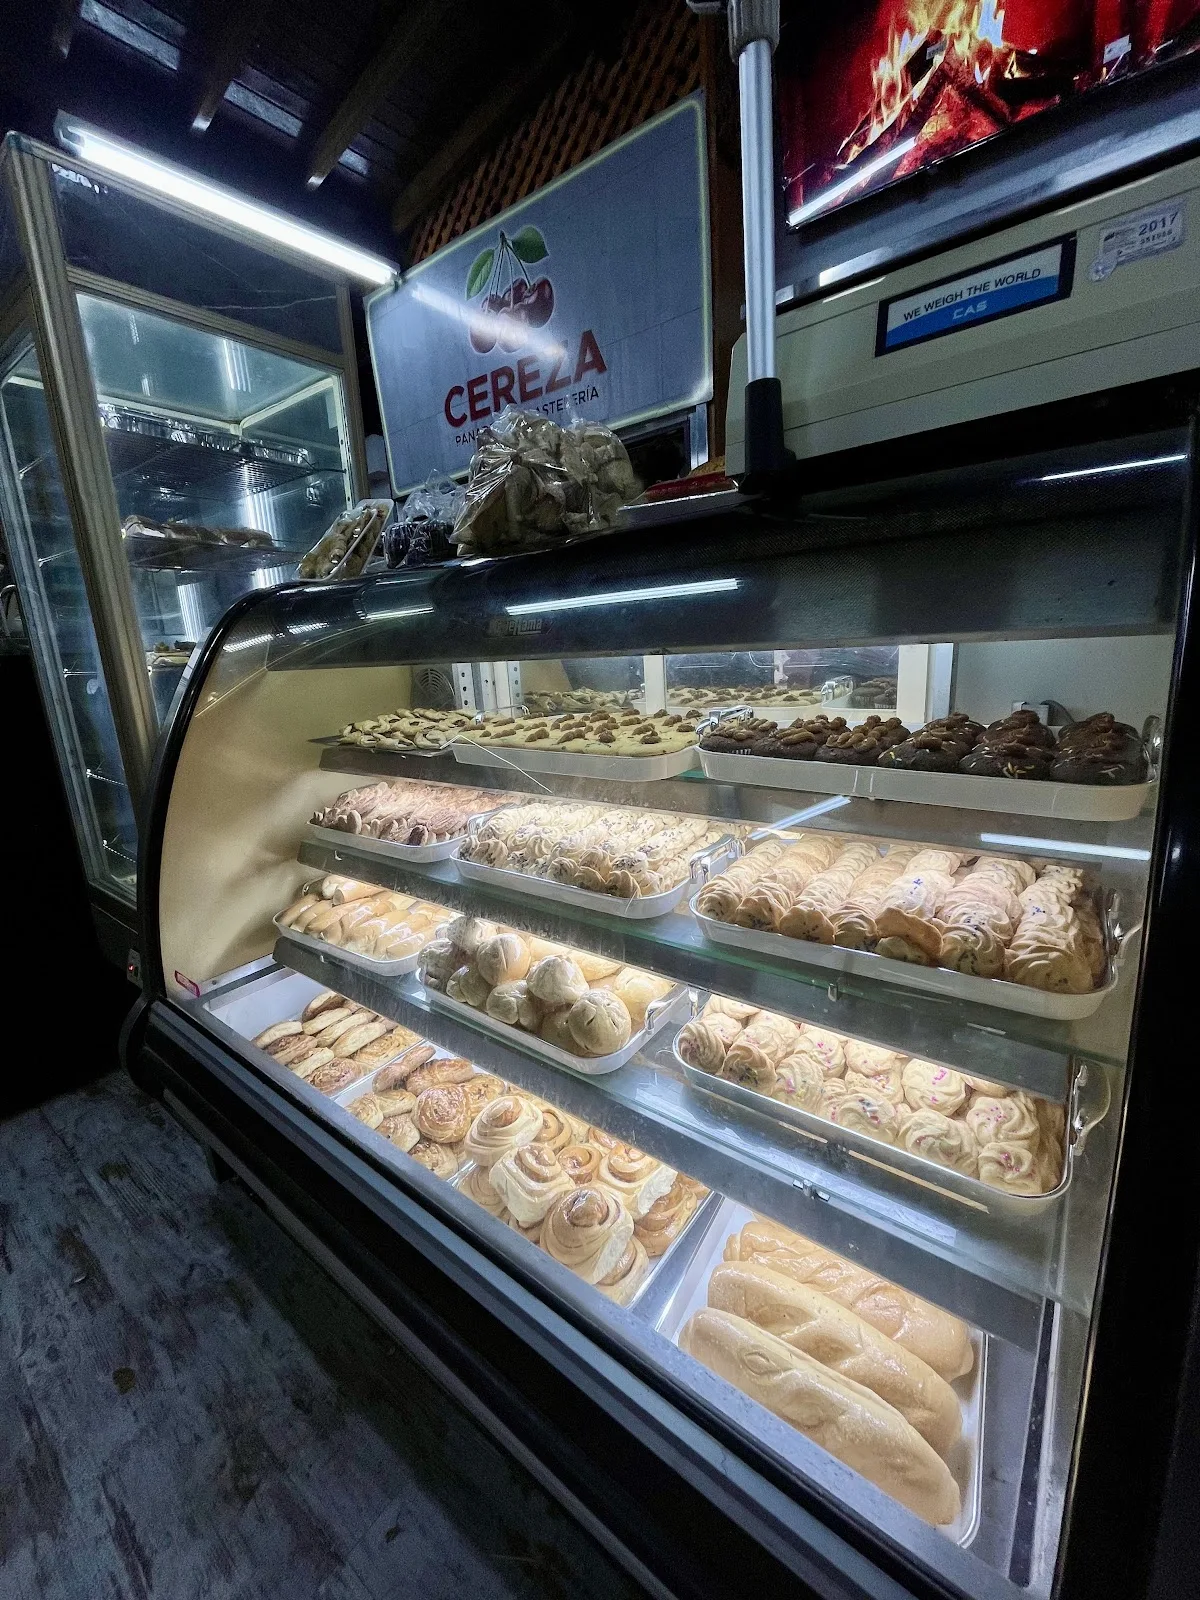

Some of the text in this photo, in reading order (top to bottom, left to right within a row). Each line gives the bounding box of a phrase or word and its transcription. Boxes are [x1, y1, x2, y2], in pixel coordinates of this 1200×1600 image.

[1138, 210, 1180, 237] 2017
[903, 268, 1041, 322] WE WEIGH THE WORLD
[952, 300, 988, 321] CAS
[444, 329, 608, 428] CEREZA
